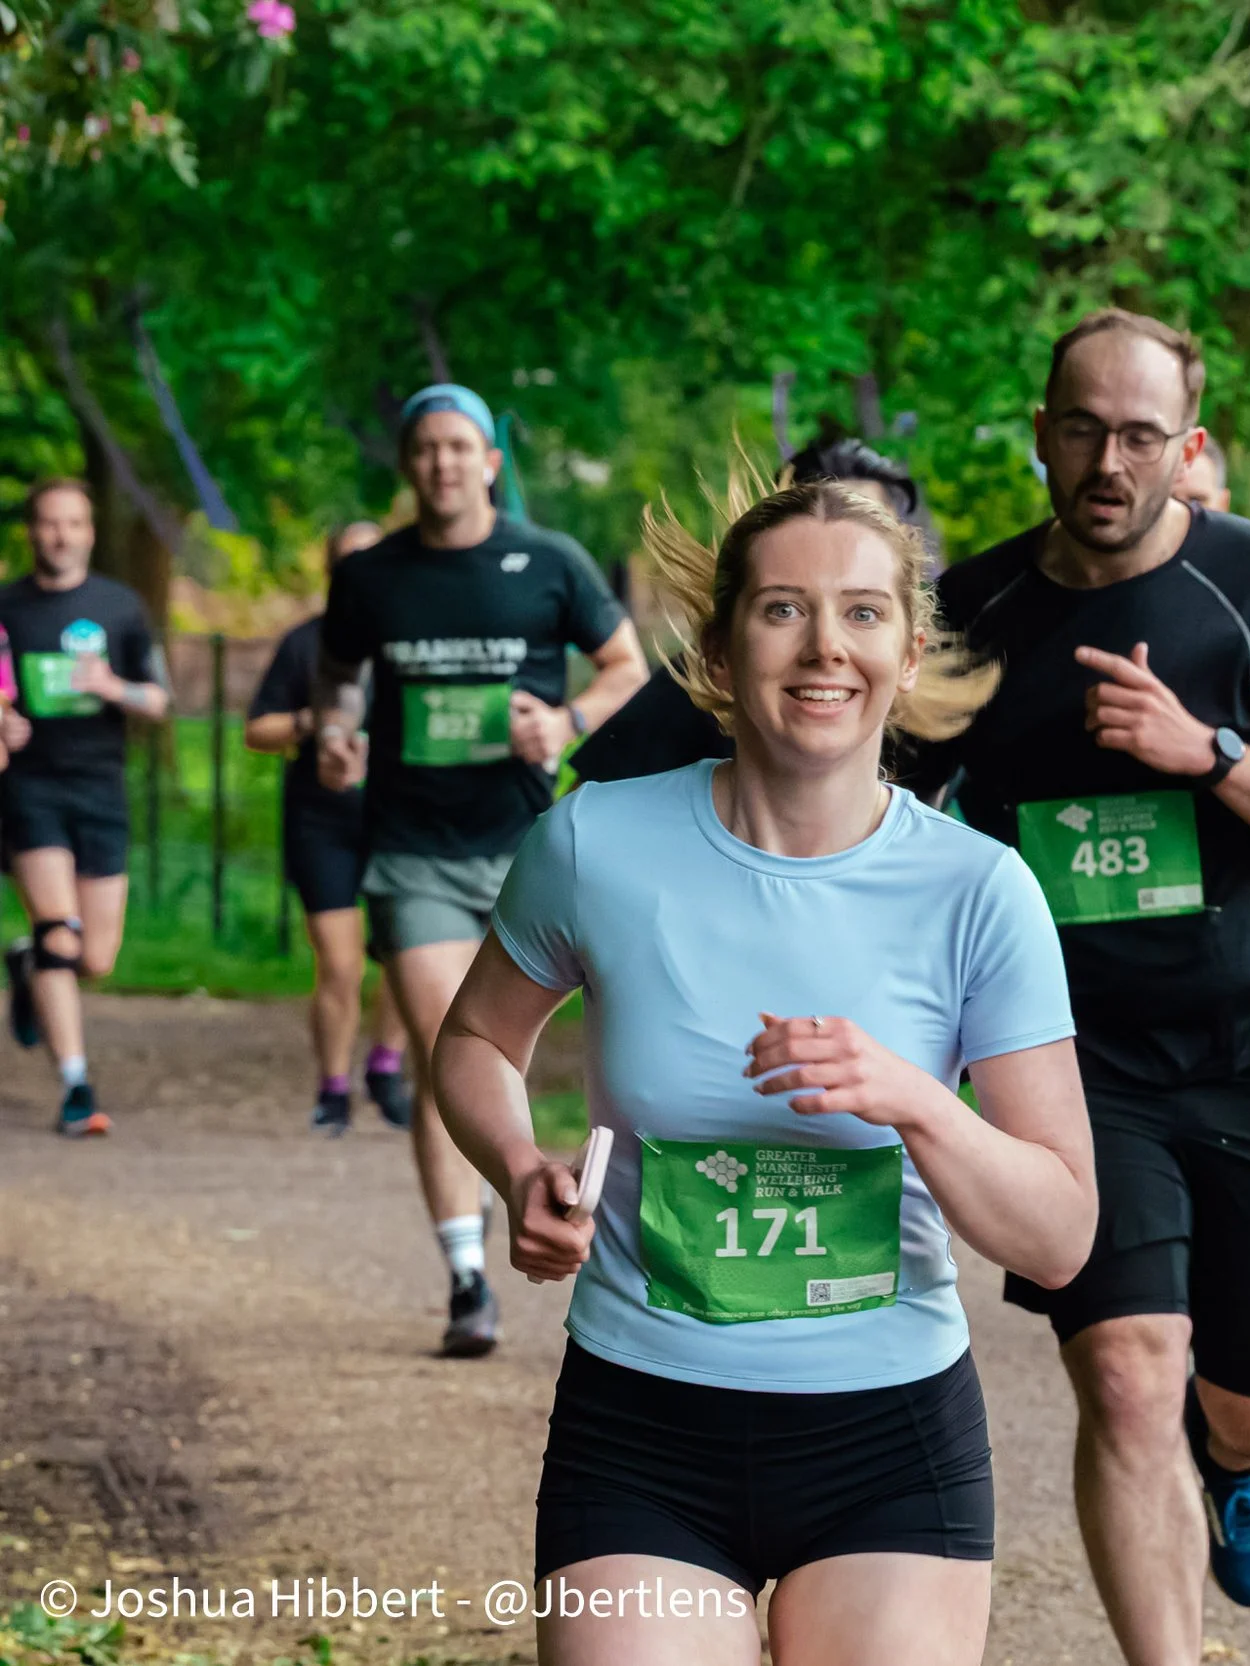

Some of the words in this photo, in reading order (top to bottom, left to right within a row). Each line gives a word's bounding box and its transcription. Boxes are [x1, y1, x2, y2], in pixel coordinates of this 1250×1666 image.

[1070, 835, 1149, 878] 483
[756, 1149, 817, 1162] GREATER
[756, 1162, 847, 1174] MANCHESTER
[756, 1173, 837, 1186] WELLBEING
[755, 1187, 785, 1198] RUN
[788, 1187, 798, 1197] &
[803, 1184, 843, 1197] WALK
[715, 1206, 827, 1257] 171
